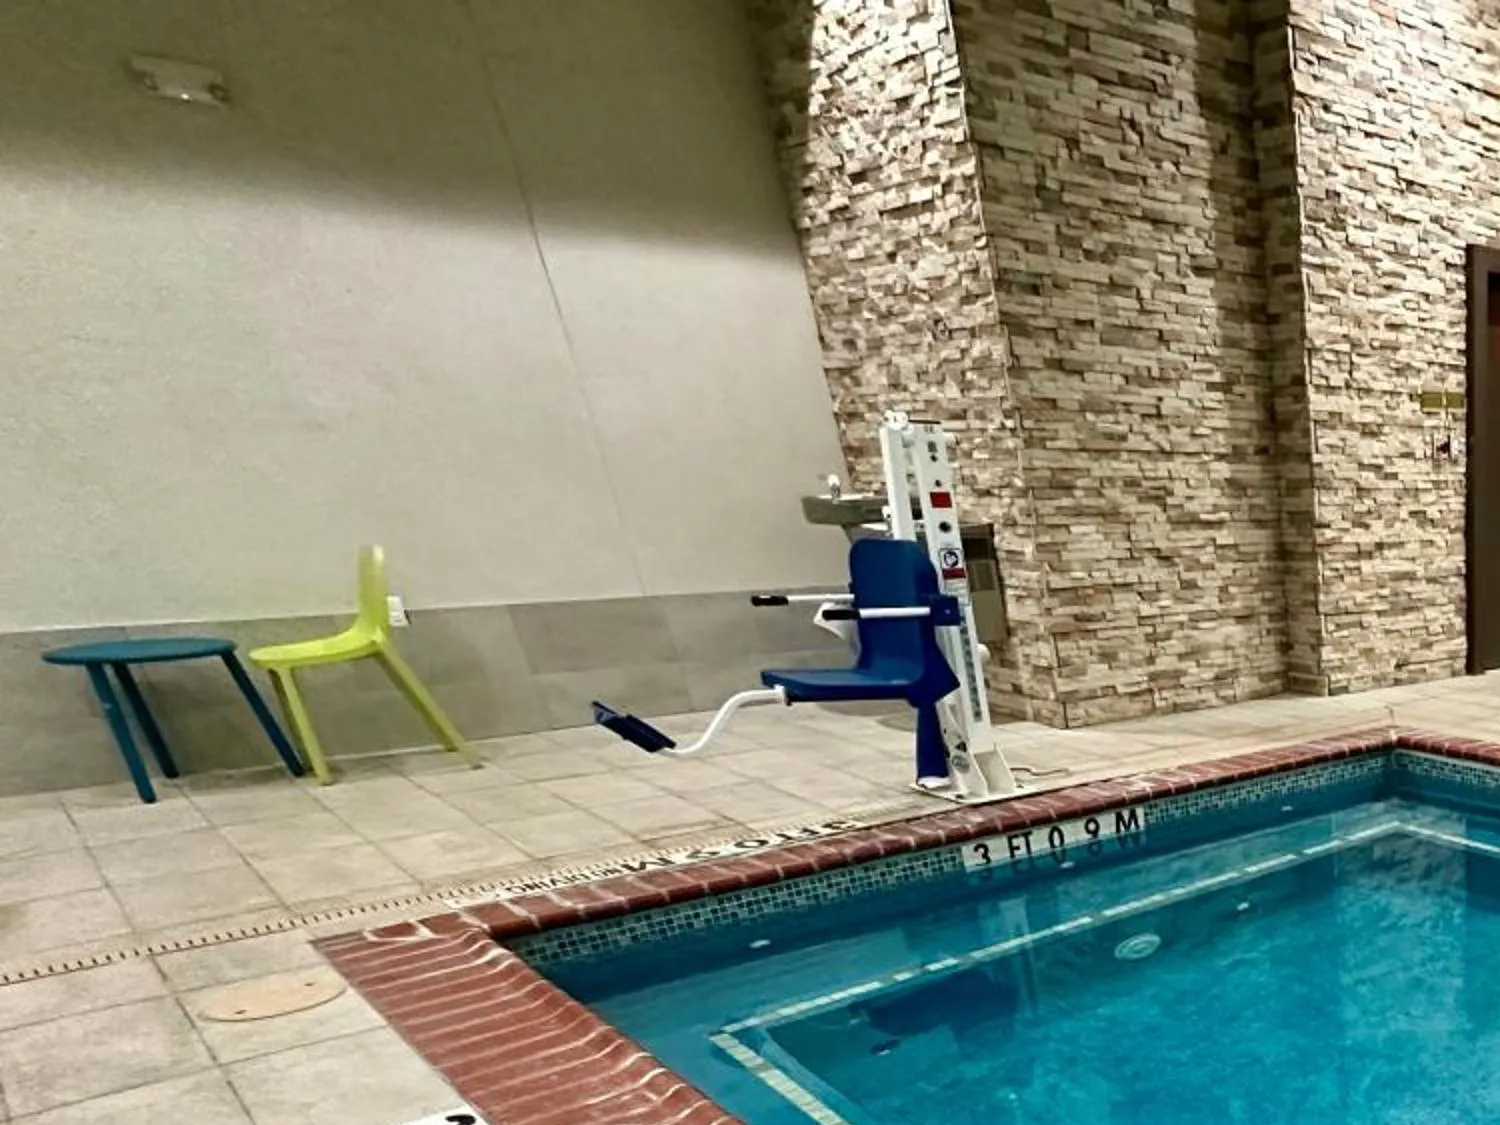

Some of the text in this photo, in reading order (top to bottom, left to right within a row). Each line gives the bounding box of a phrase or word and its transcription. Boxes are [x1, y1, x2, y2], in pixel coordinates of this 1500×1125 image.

[974, 843, 991, 866] 3
[1007, 831, 1033, 858] FT
[1115, 808, 1140, 833] M
